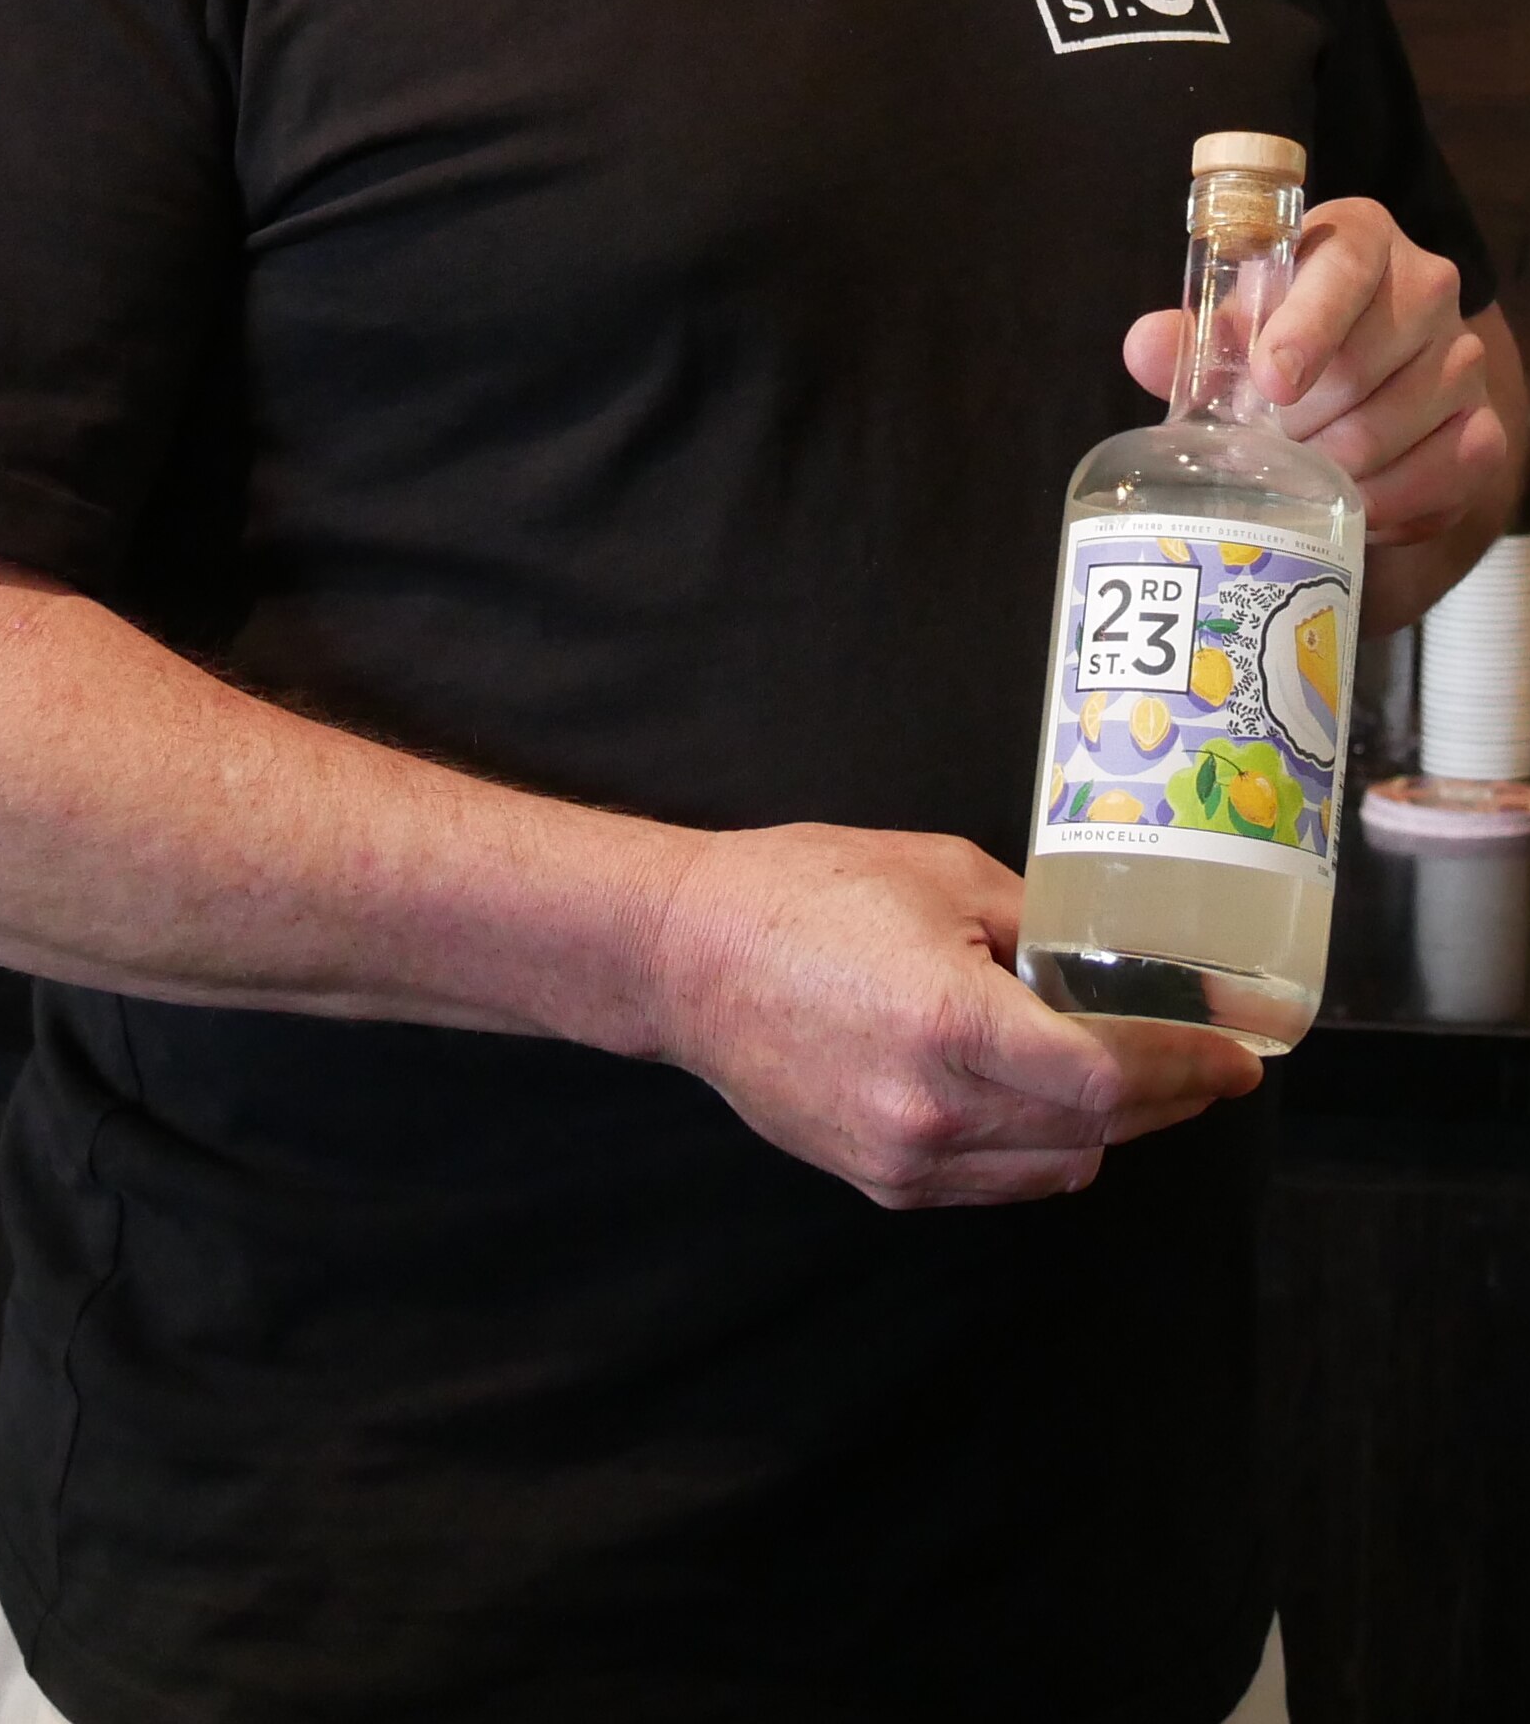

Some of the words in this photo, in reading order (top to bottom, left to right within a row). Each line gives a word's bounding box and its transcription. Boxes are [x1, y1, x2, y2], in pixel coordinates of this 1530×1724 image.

[1132, 522, 1163, 531] THIRD
[1171, 523, 1212, 535] STREET
[1140, 578, 1182, 602] RD
[1088, 652, 1126, 675] ST.
[1061, 830, 1160, 845] LIMONCELLO
